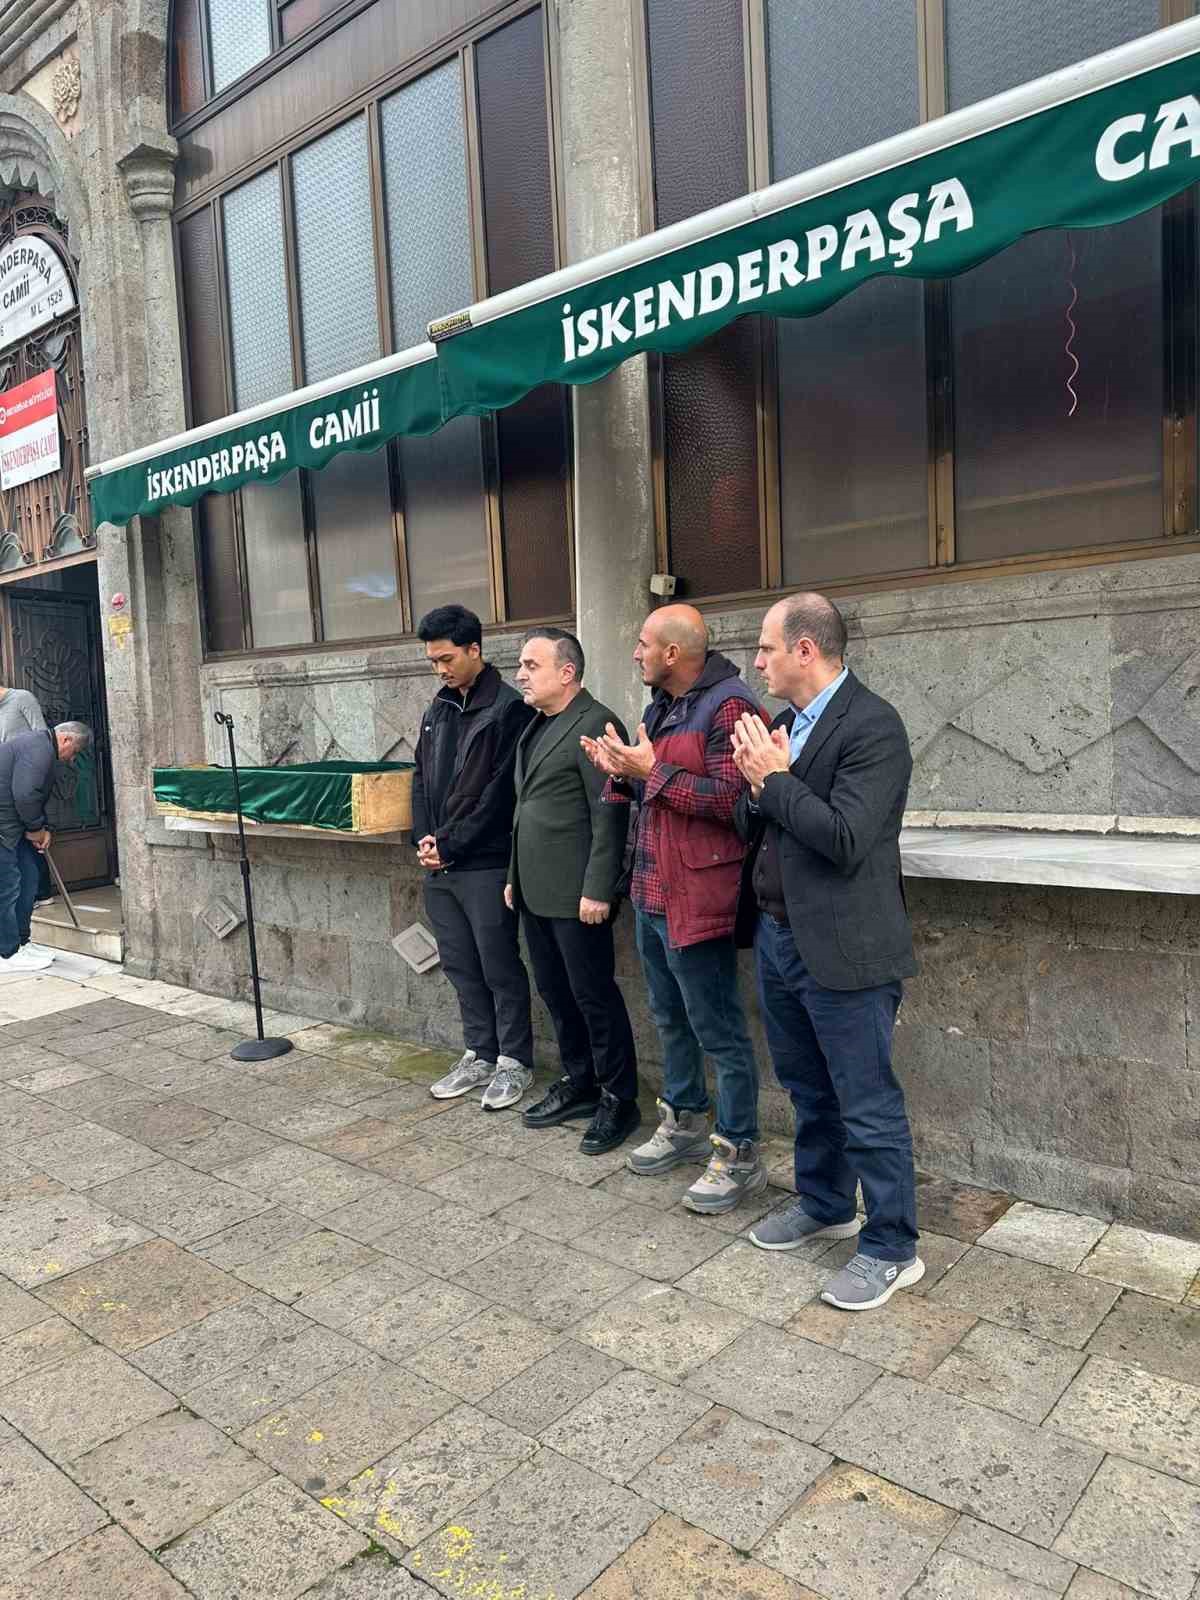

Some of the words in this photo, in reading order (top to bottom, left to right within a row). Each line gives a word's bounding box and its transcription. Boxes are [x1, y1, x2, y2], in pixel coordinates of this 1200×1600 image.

[562, 177, 975, 363] İSKENDERPAŞA
[147, 431, 287, 501] İSKENDERPAŞA
[309, 388, 380, 449] CAMİİ
